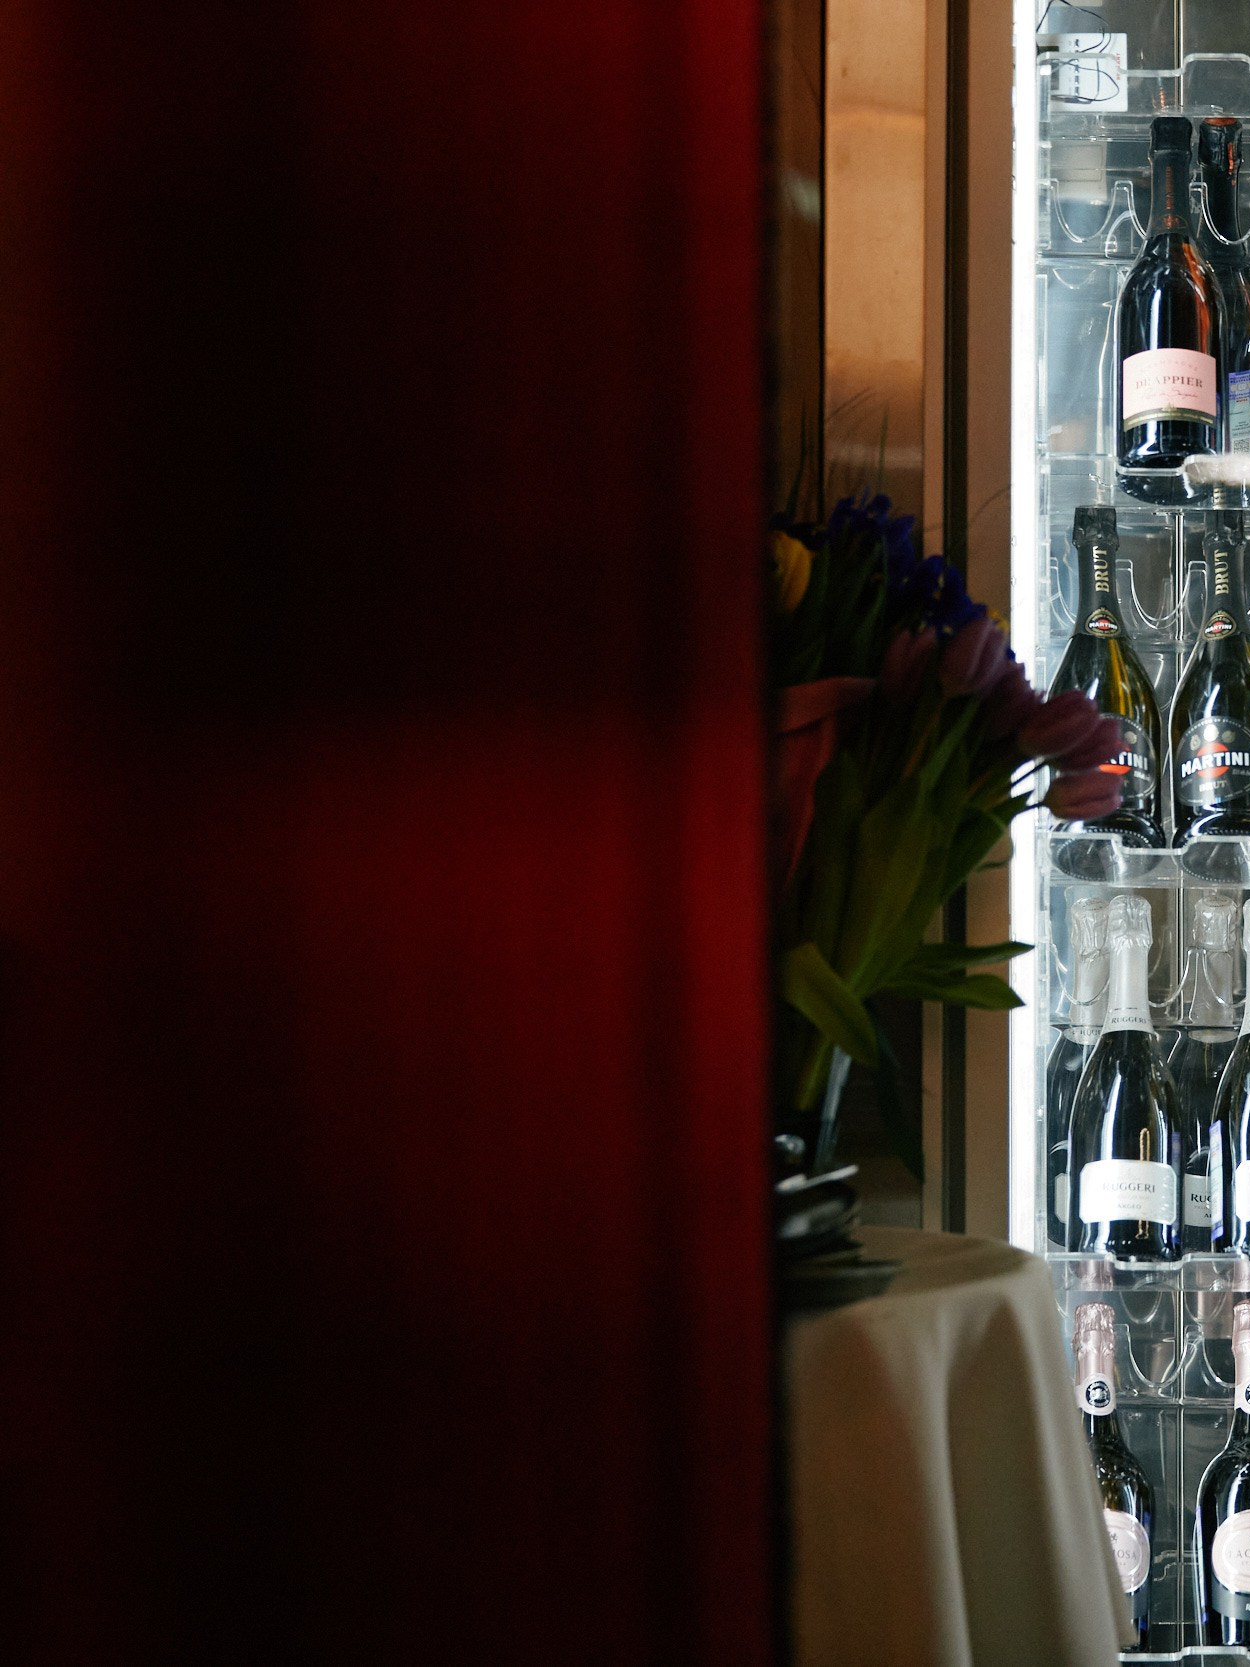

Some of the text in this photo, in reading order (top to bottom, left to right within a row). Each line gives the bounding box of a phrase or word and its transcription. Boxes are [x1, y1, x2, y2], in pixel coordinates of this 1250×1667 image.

[1093, 546, 1110, 593] BRUT
[1214, 549, 1229, 595] BRUT
[1089, 621, 1117, 630] MARTINI
[1205, 624, 1232, 633] MARTINI
[1181, 752, 1249, 778] MARTINI
[1102, 1181, 1156, 1193] RUGGERI
